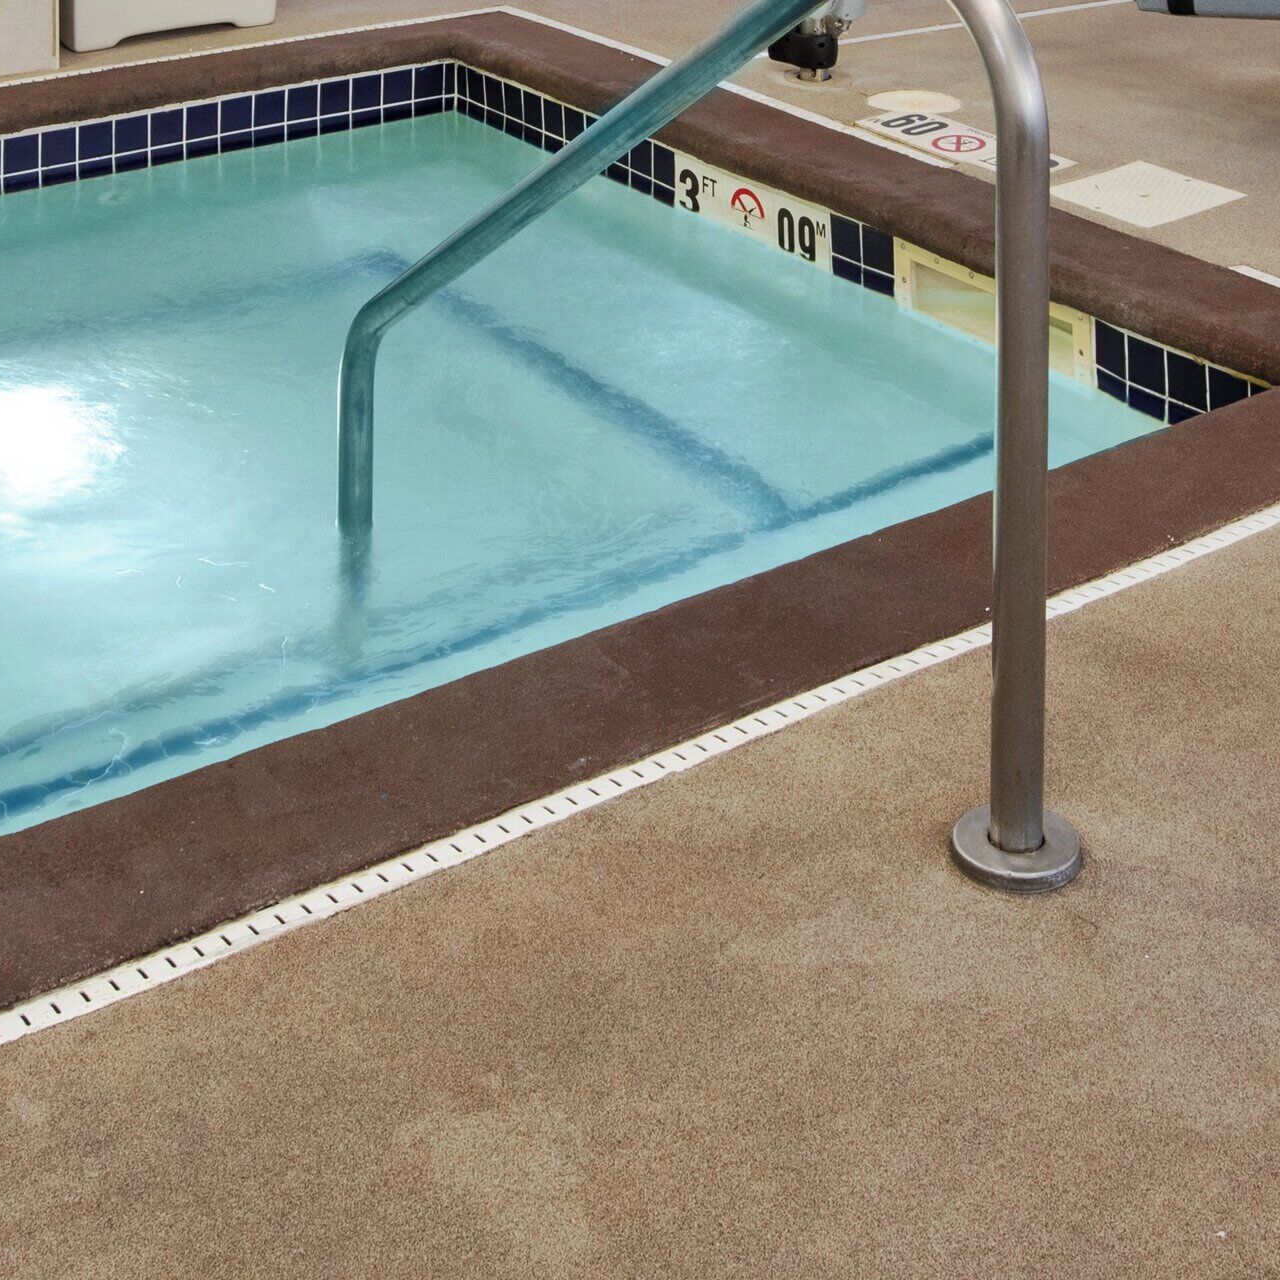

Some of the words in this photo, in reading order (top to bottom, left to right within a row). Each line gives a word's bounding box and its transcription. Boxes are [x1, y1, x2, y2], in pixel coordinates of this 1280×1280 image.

[679, 169, 700, 212] 3
[702, 175, 717, 198] FT
[816, 220, 826, 239] M
